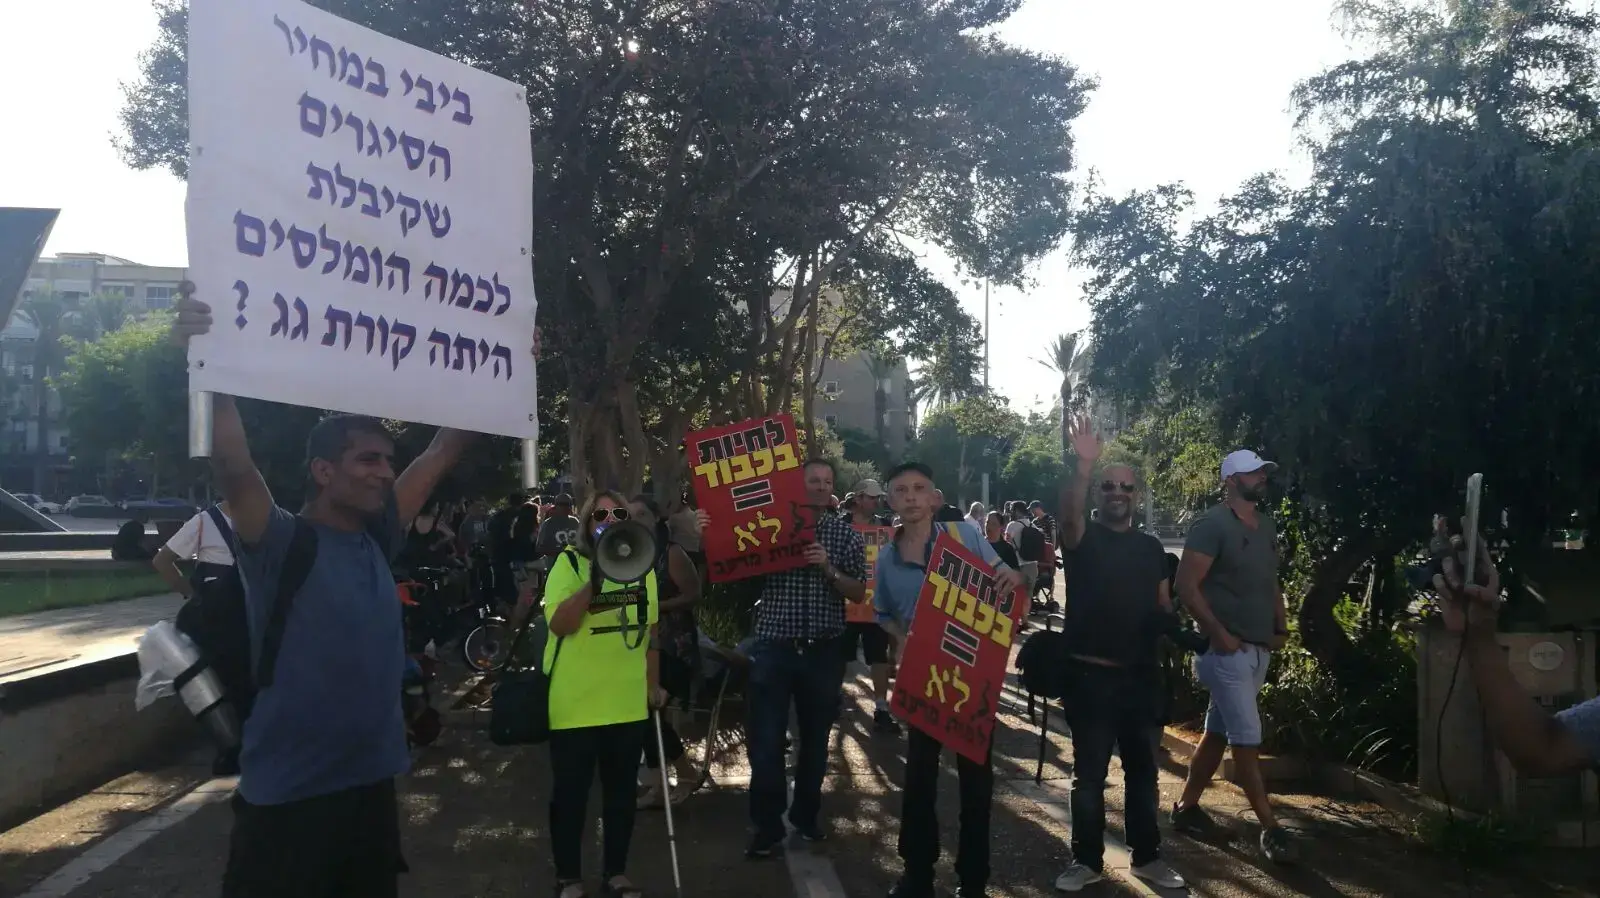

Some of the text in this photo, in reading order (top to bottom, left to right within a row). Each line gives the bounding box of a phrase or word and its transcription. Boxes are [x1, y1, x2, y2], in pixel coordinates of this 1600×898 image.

[273, 13, 474, 126] ביבי במחיר
[297, 90, 452, 182] הסיגרים
[306, 160, 452, 239] שקיבלת
[233, 209, 512, 317] לכמה הומלסים
[269, 292, 309, 342] גג
[320, 304, 417, 372] קורת
[427, 328, 513, 382] היתה
[695, 443, 800, 489] בכבוד
[696, 418, 786, 465] לחיות
[733, 510, 783, 552] לא
[928, 570, 1013, 648] בכבוד
[925, 664, 971, 713] לא
